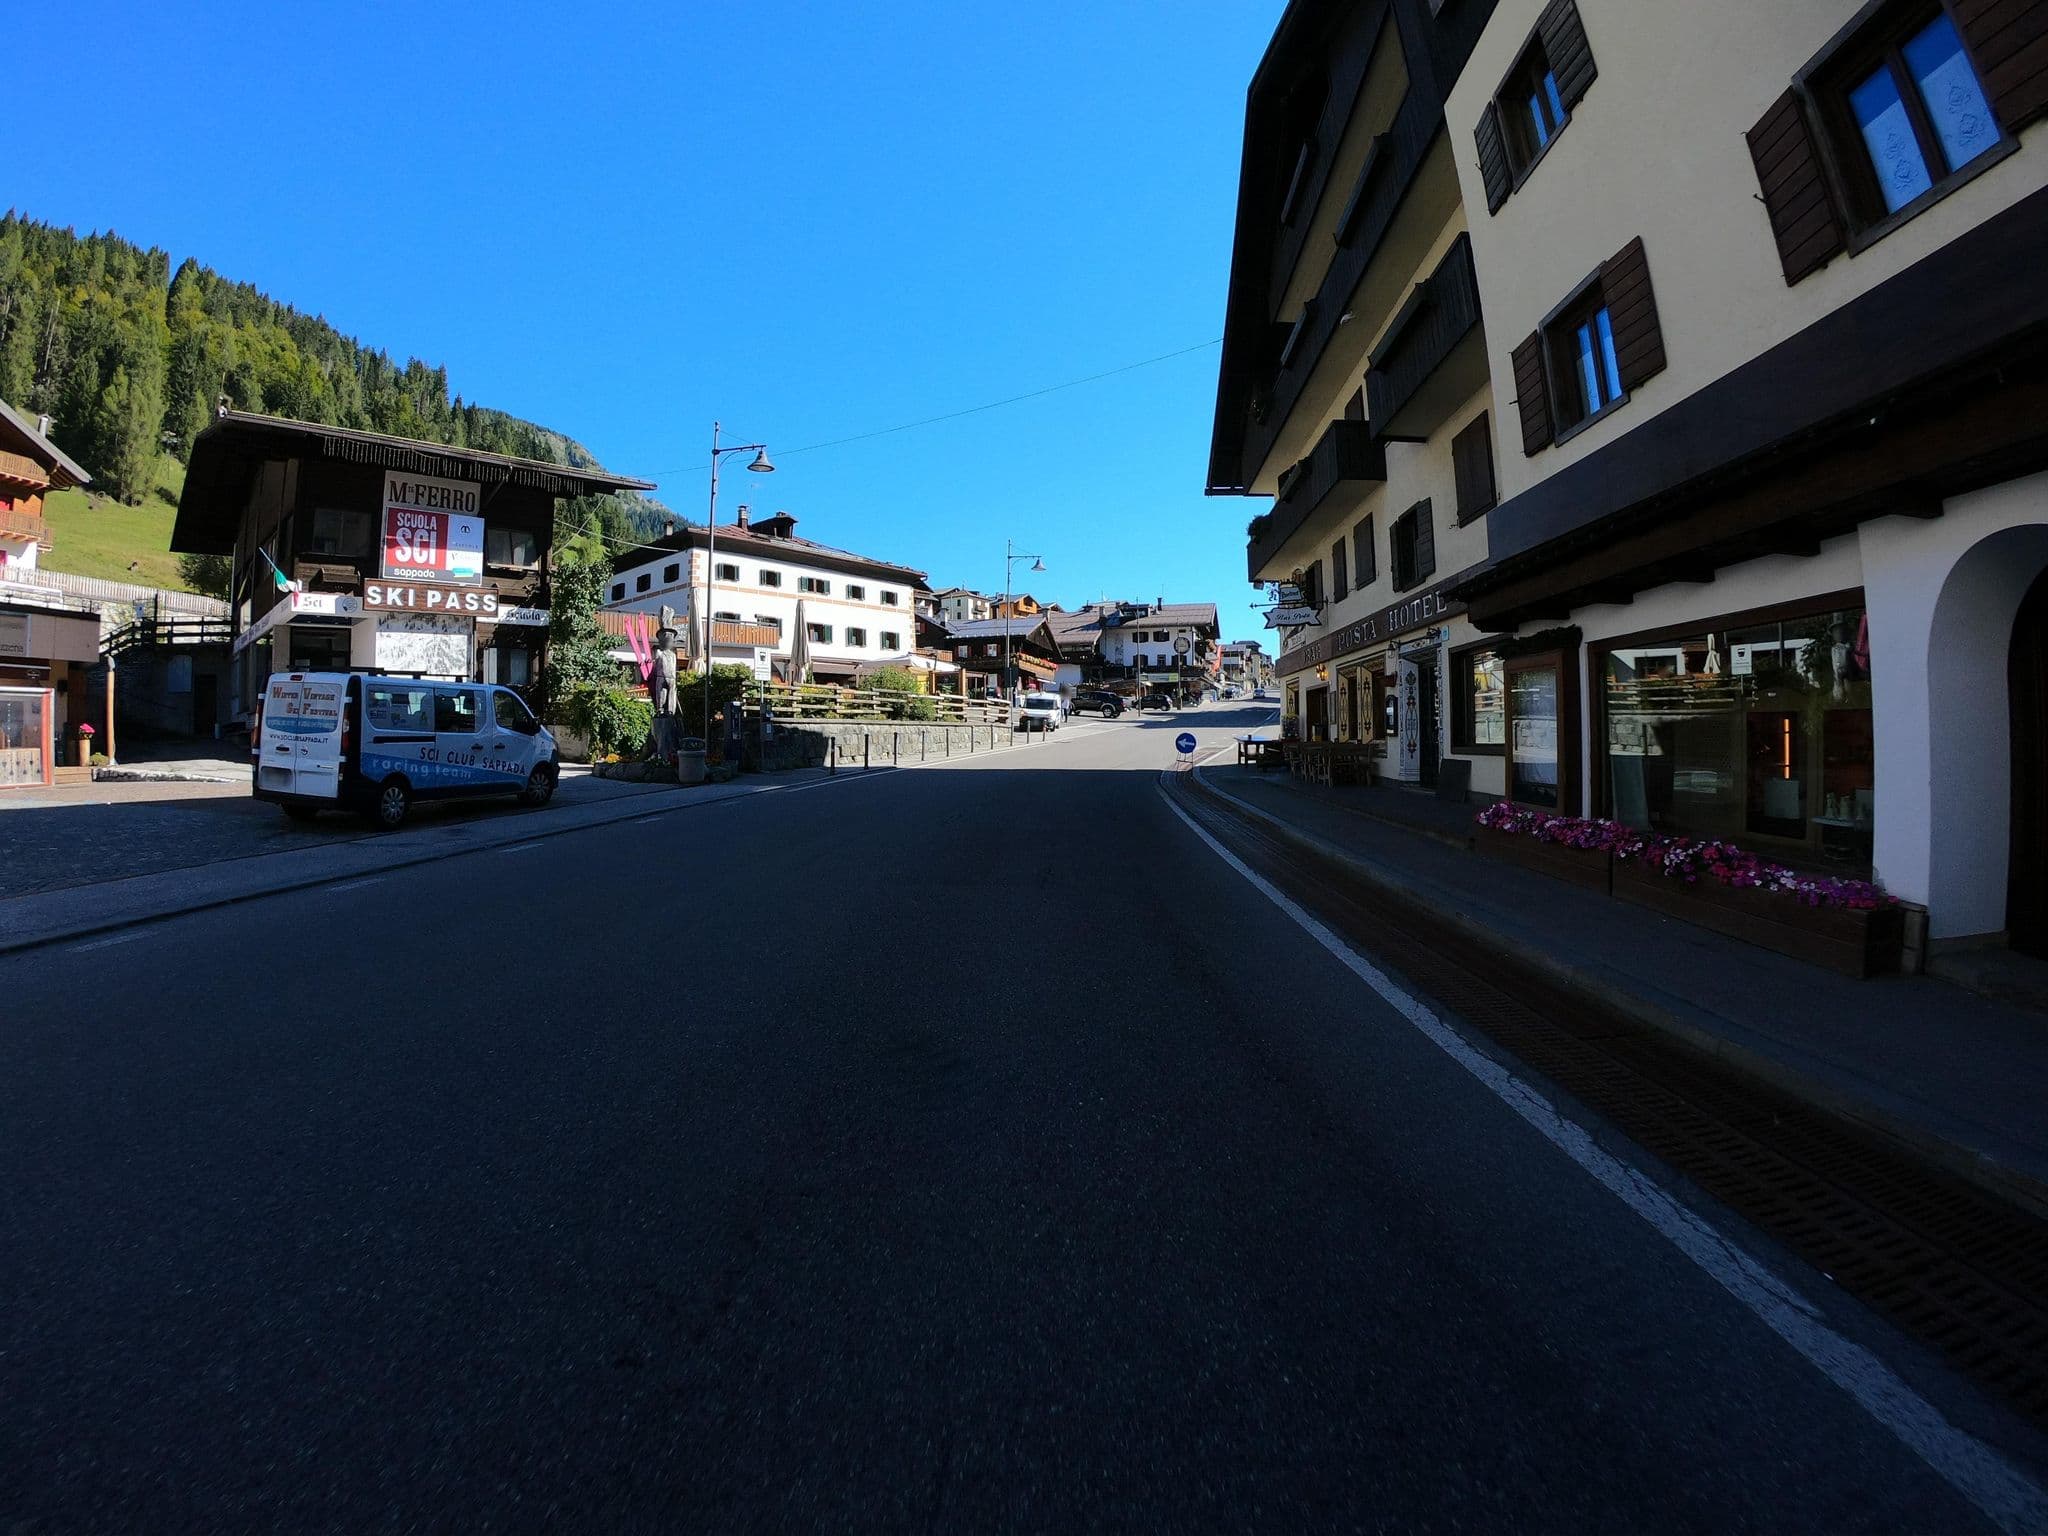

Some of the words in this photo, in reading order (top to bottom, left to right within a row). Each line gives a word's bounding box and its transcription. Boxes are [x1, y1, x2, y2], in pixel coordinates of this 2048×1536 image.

[414, 483, 476, 512] FERRO
[397, 512, 437, 530] SCUOLA
[394, 527, 437, 565] SCI
[394, 567, 435, 579] sappada
[366, 585, 415, 607] SKI
[427, 589, 497, 612] PASS
[1338, 620, 1377, 651] POSTA
[1388, 590, 1448, 632] HOTEL
[372, 758, 429, 777] racing
[436, 762, 472, 779] team
[419, 746, 439, 762] SCI
[447, 751, 476, 767] CLUB
[482, 757, 526, 776] SAPPADA
